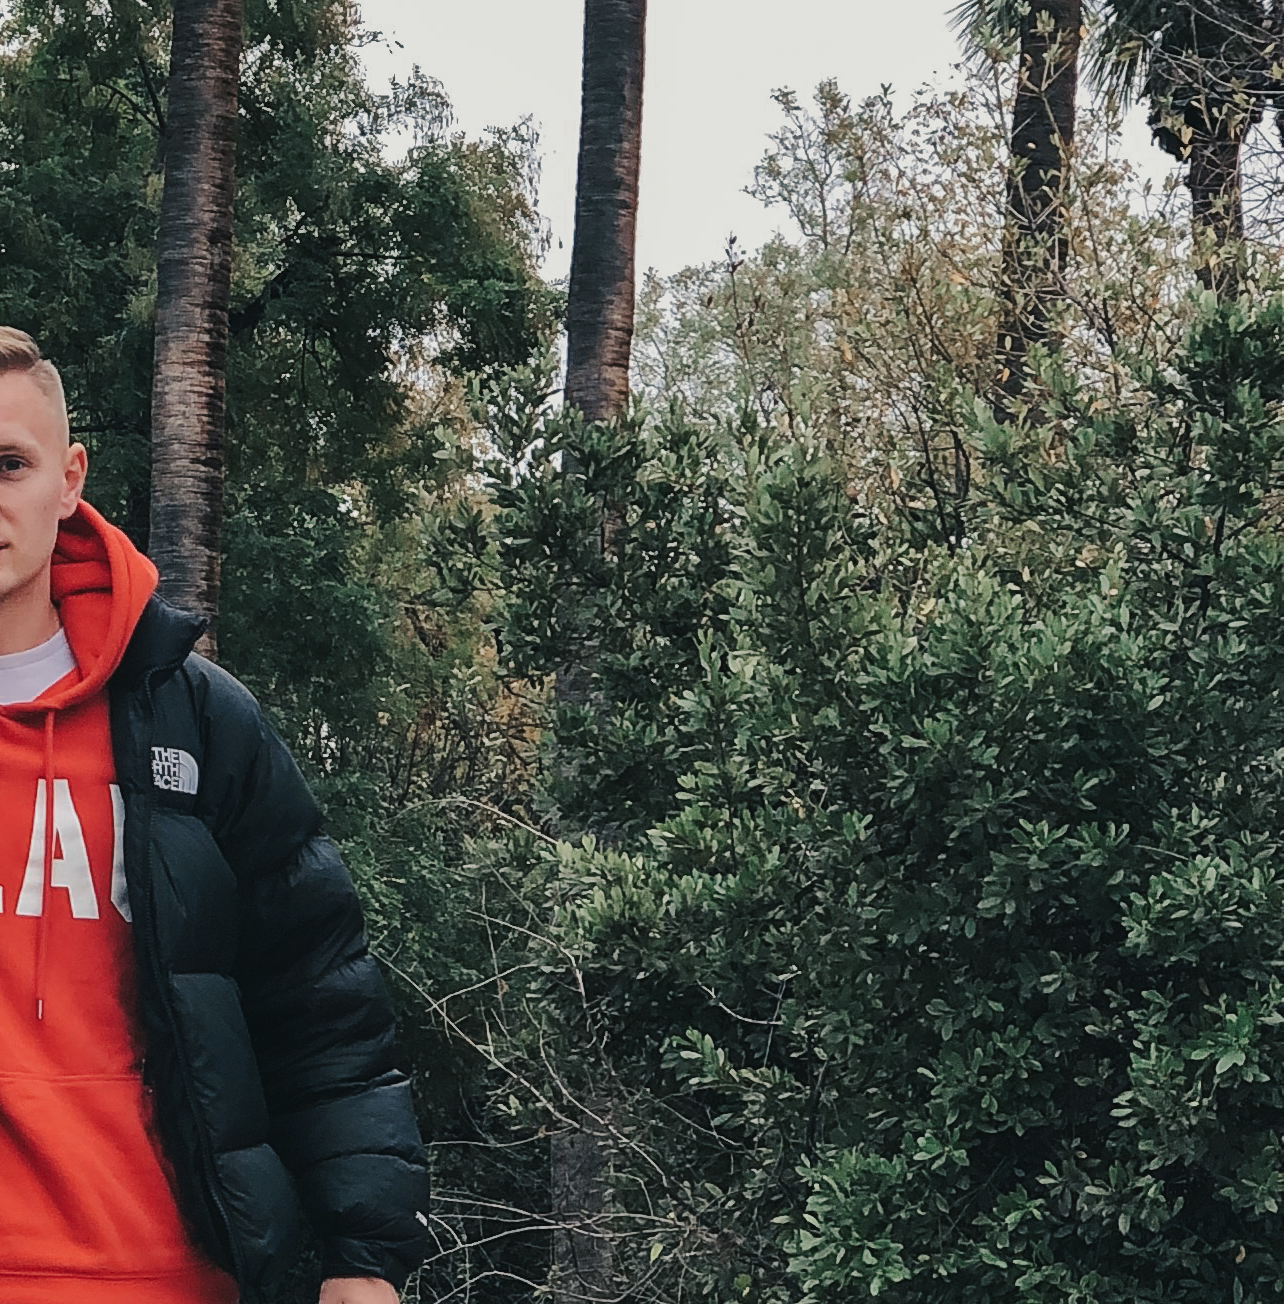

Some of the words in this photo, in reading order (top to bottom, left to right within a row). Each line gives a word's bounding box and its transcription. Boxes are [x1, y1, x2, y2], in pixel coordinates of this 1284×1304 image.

[151, 747, 179, 763] THE
[151, 760, 179, 776] RTH
[153, 774, 179, 791] ACE
